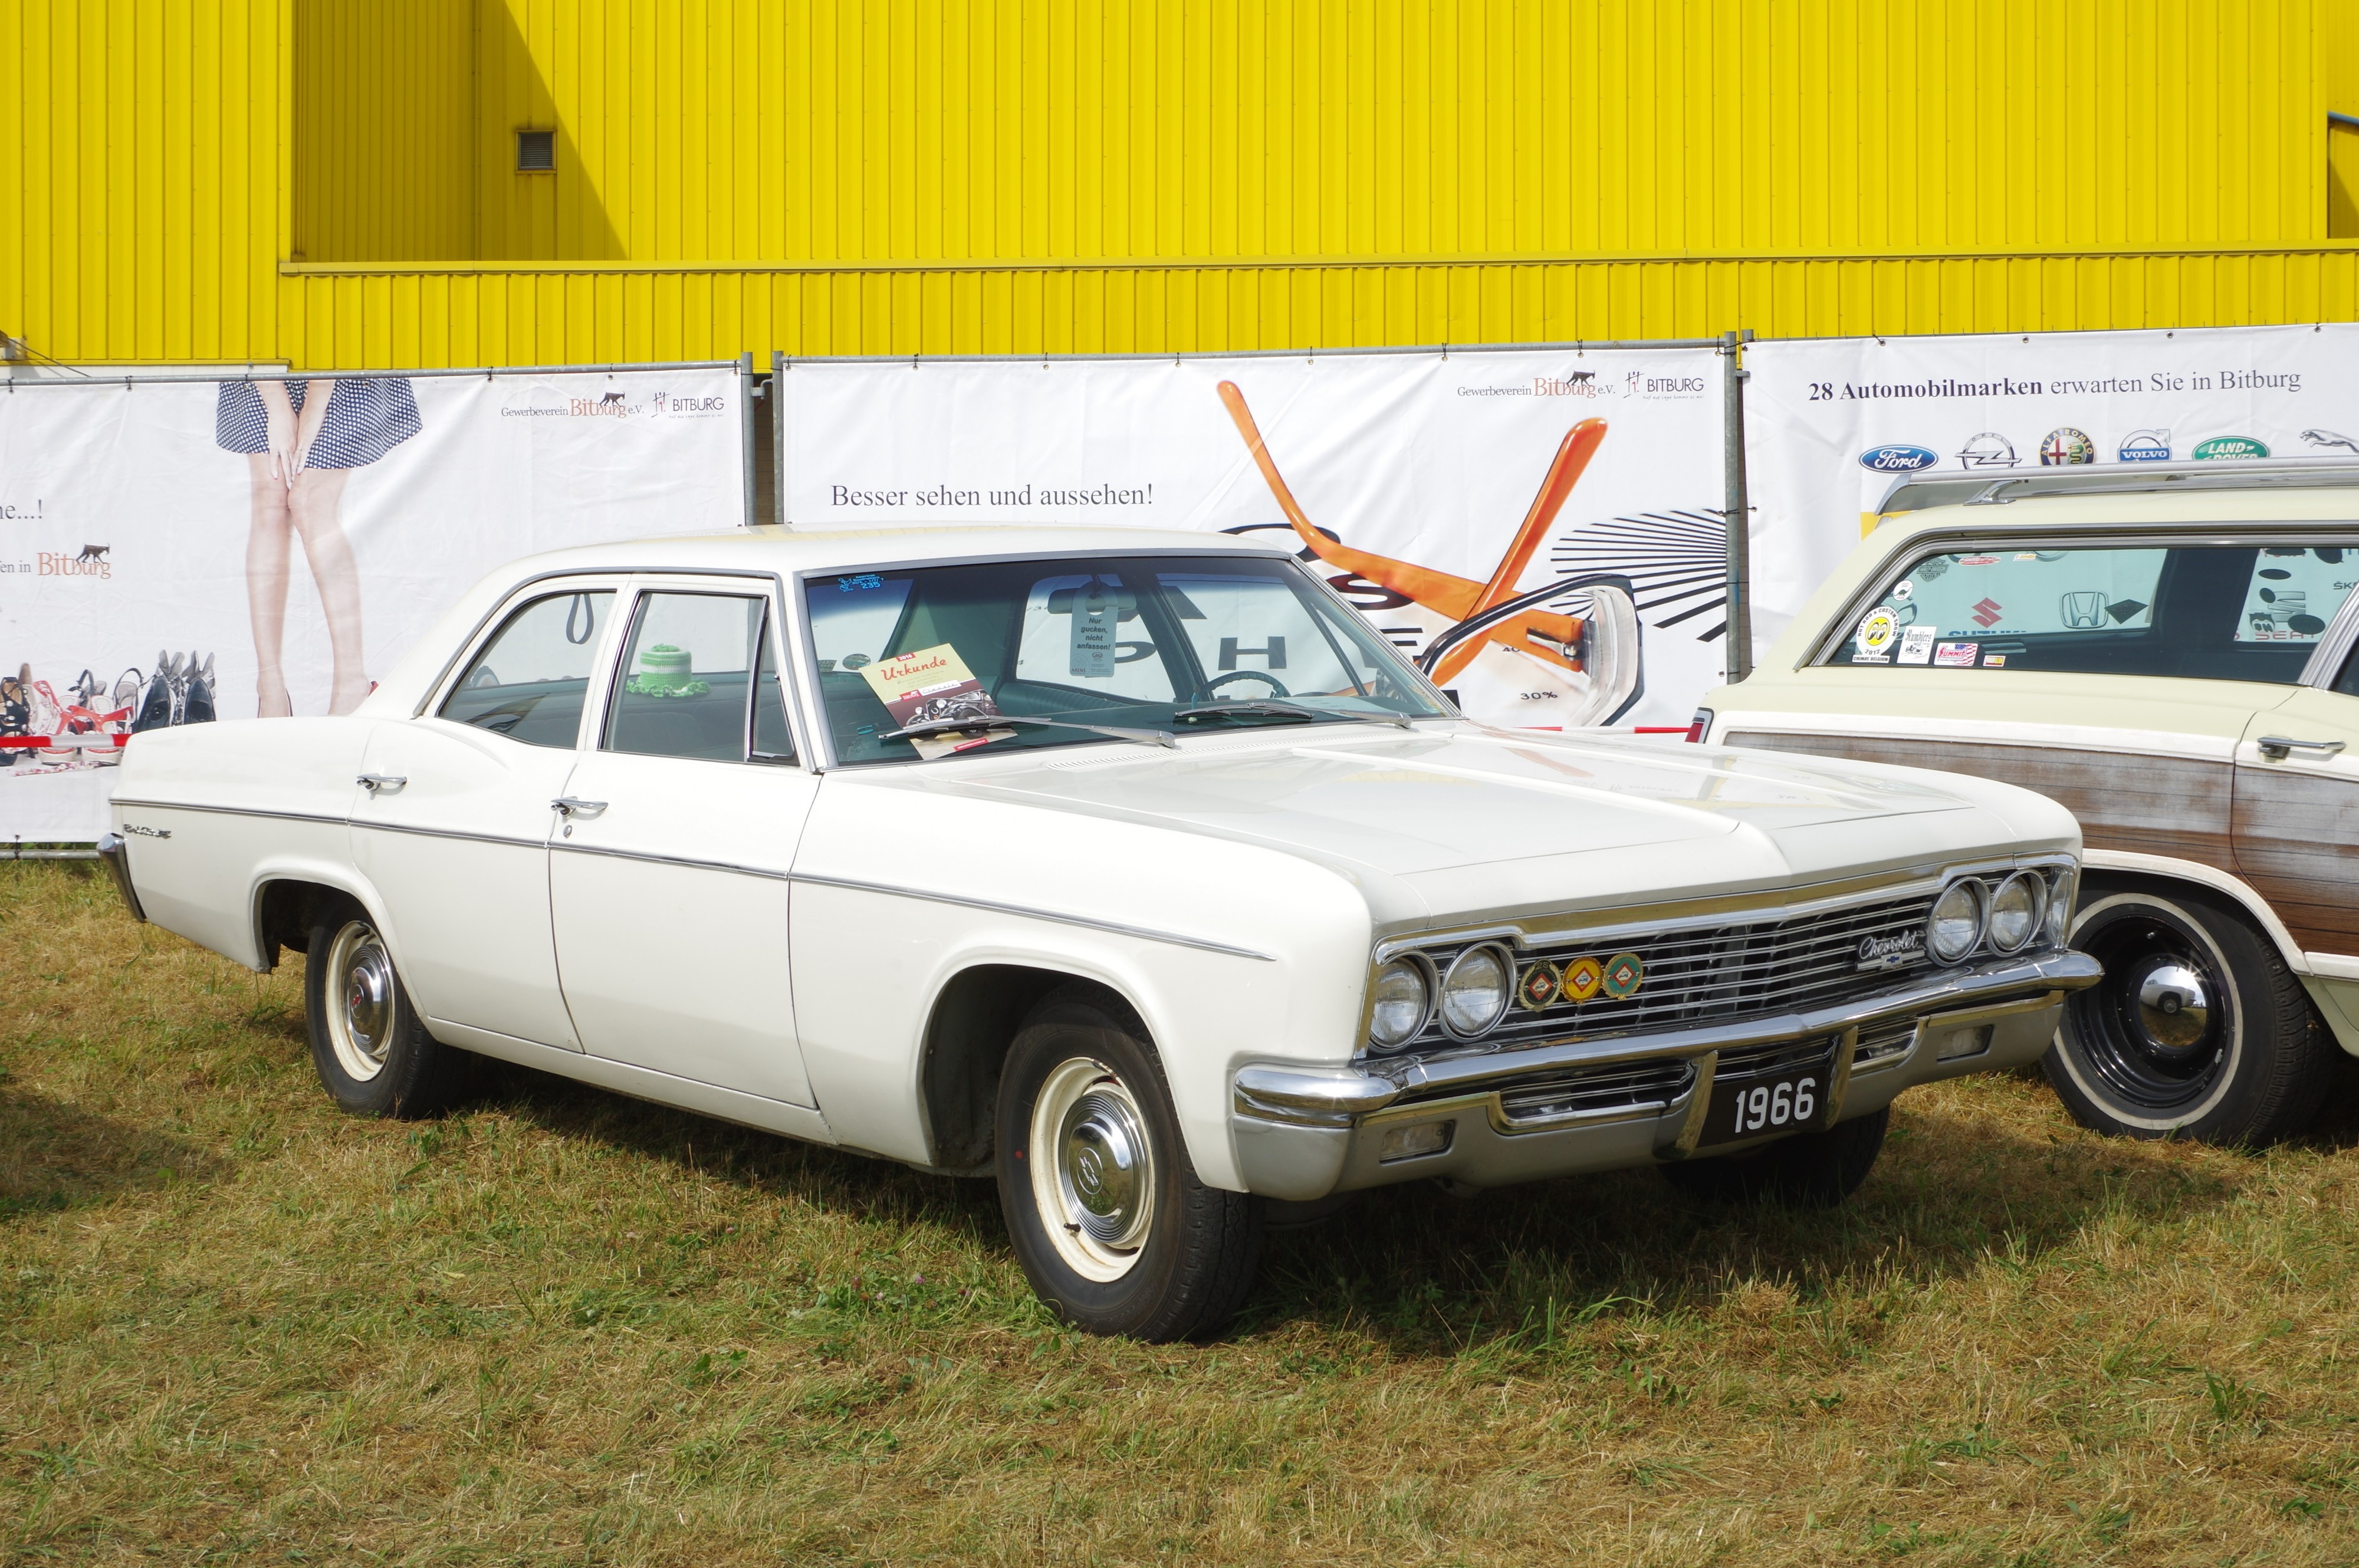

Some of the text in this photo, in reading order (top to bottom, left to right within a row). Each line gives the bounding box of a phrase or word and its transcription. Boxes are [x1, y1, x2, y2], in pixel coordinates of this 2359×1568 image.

[1457, 377, 1616, 399] Gewerbeverein Bitburg e.V.
[1647, 377, 1704, 392] BITBURG
[1808, 369, 2301, 400] 28 Automobilmarken erwarten Sie in Bitburg
[501, 399, 645, 419] Gewerbeverein Bitburg e.V.
[673, 397, 724, 412] BITBURG
[2041, 429, 2093, 456] ALFA ROMEO
[1874, 449, 1924, 469] Ford
[2121, 450, 2168, 459] VOLVO
[831, 482, 1153, 507] Besser sehen und aussehen!
[19, 560, 31, 573] in
[37, 552, 111, 580] Bitburg
[1878, 608, 1897, 618] CUSTOM
[1905, 629, 1932, 642] Rumblers
[1937, 646, 1966, 662] SUMMIT
[881, 656, 947, 681] Urkunde
[1520, 692, 1558, 700] 30%
[1859, 929, 1921, 959] Chevrolet
[1535, 962, 1549, 970] 25
[1735, 1077, 1816, 1133] 1966
